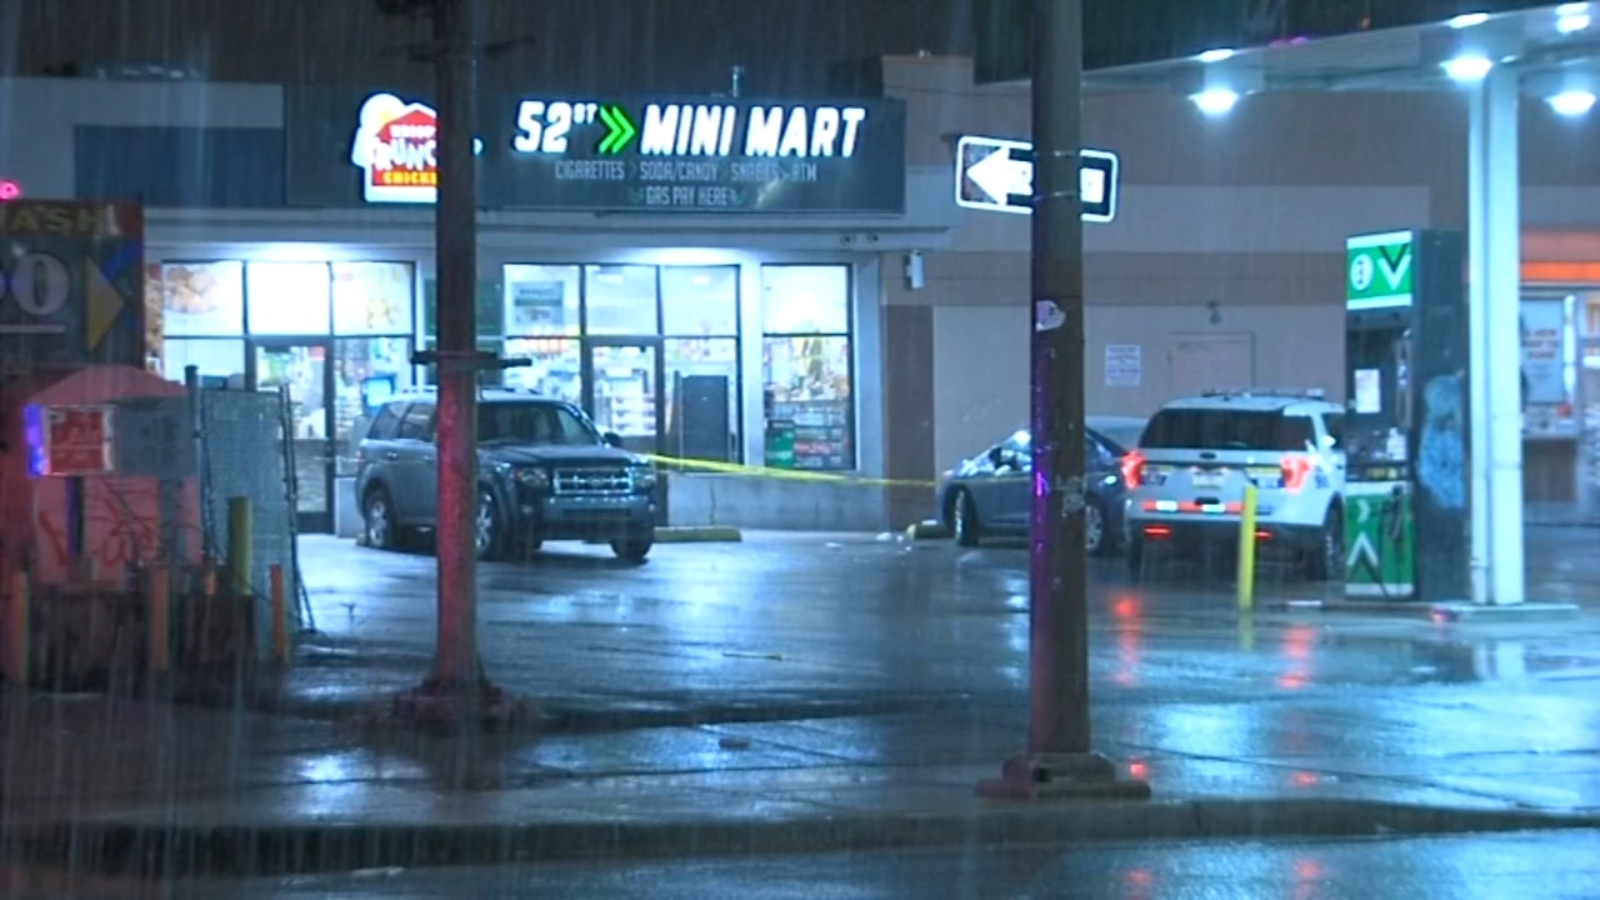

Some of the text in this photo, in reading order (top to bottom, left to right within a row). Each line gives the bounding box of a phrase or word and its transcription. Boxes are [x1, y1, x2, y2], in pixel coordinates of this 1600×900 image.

[640, 104, 736, 155] MINI
[745, 106, 866, 157] MART
[383, 171, 438, 184] CHICK
[555, 160, 625, 179] CIGARETTES
[646, 186, 728, 206] GAS PAY HERE
[0, 203, 107, 233] ASH
